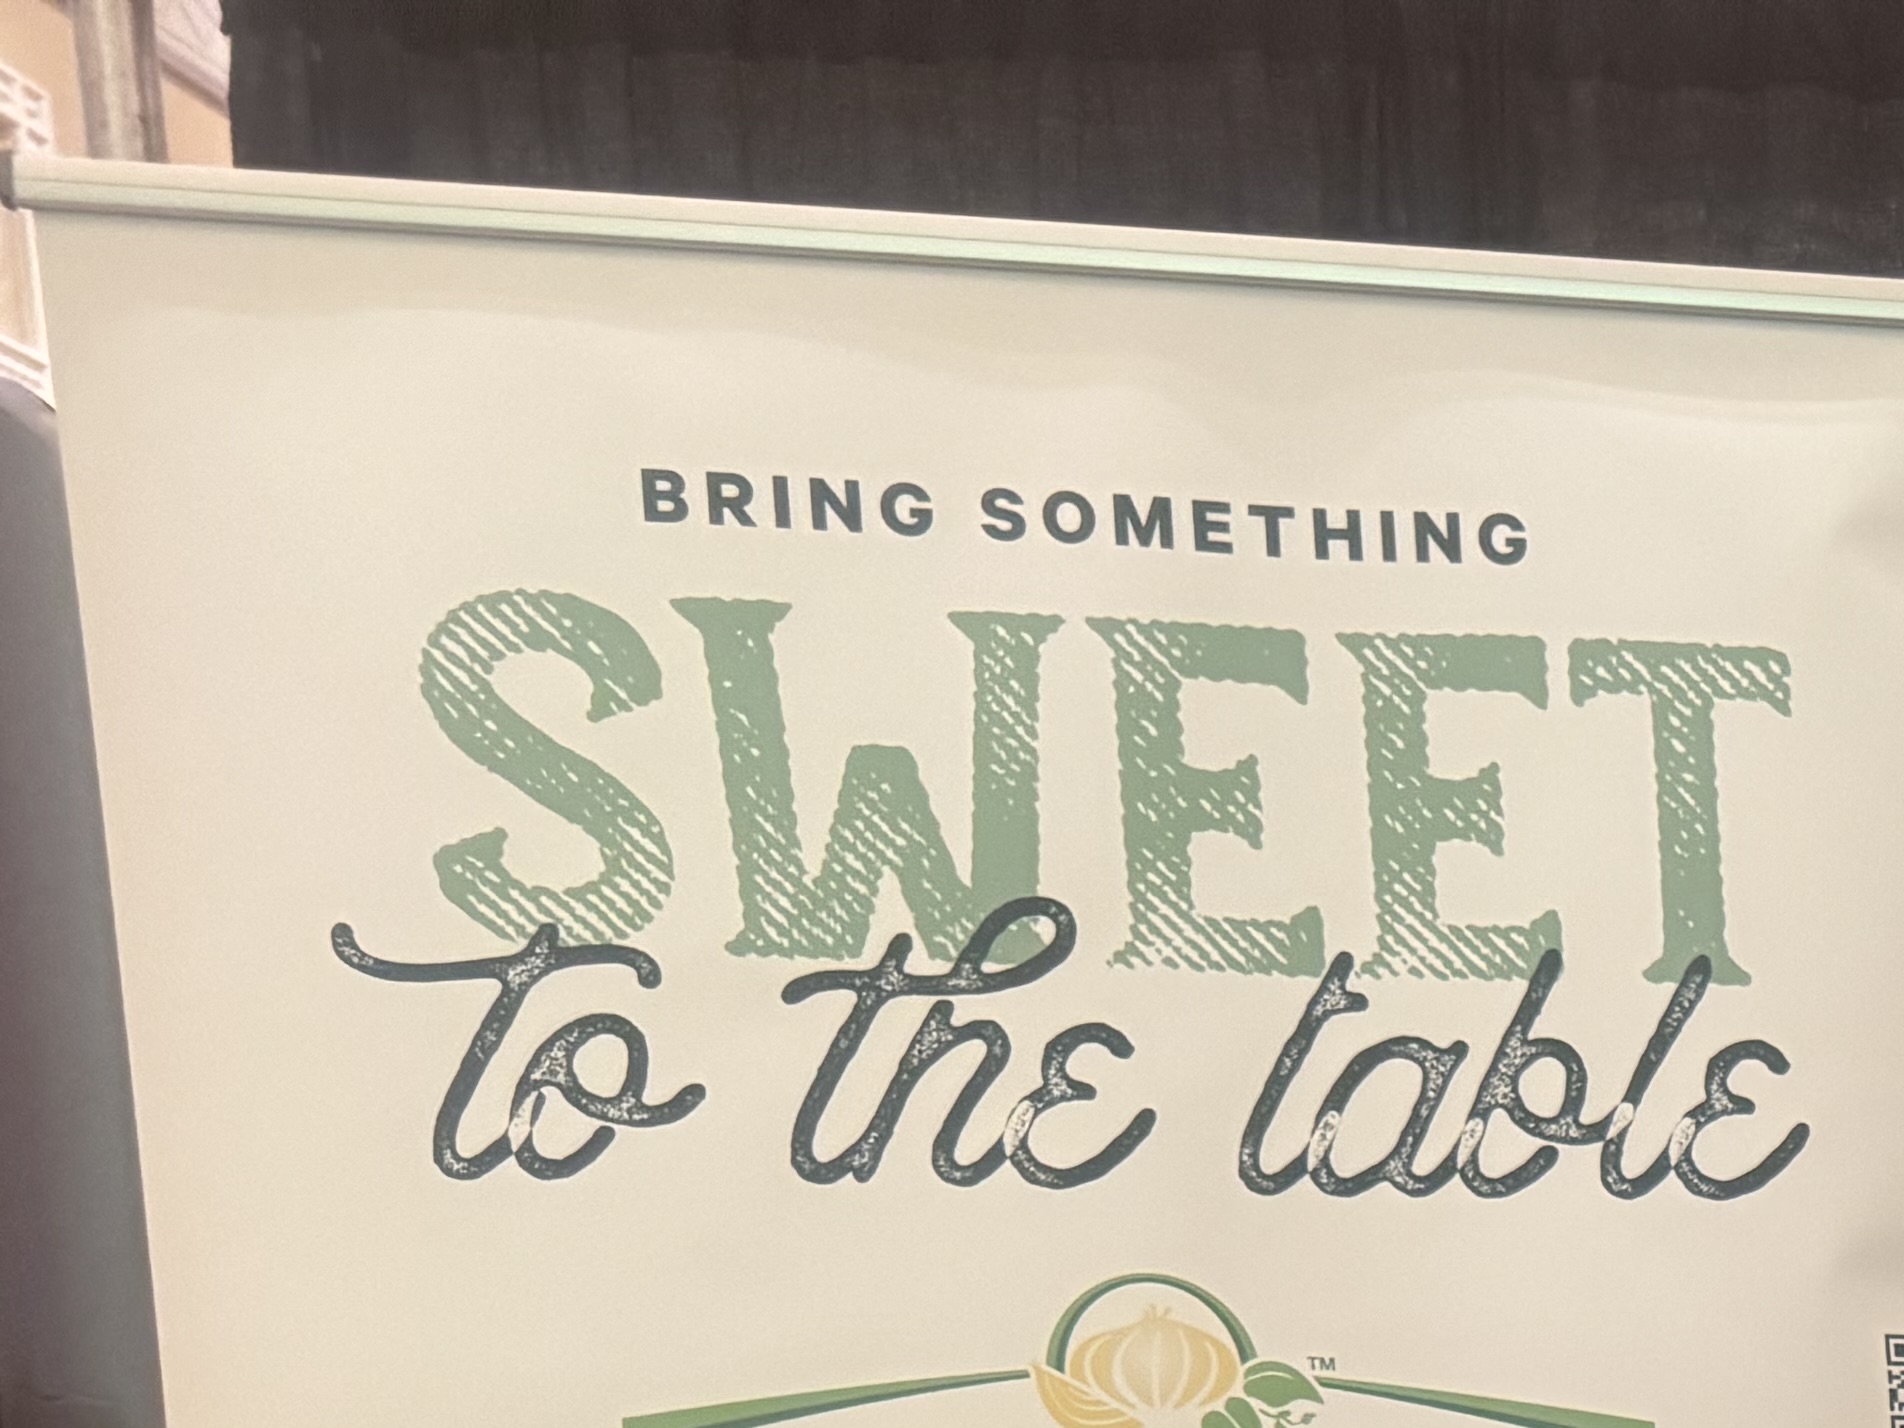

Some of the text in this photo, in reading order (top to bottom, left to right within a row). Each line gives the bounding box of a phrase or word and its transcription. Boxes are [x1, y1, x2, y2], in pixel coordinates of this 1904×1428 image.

[640, 467, 1532, 566] BRING SOMETHING
[418, 587, 1793, 986] SWEET
[331, 896, 1810, 1199] to the table
